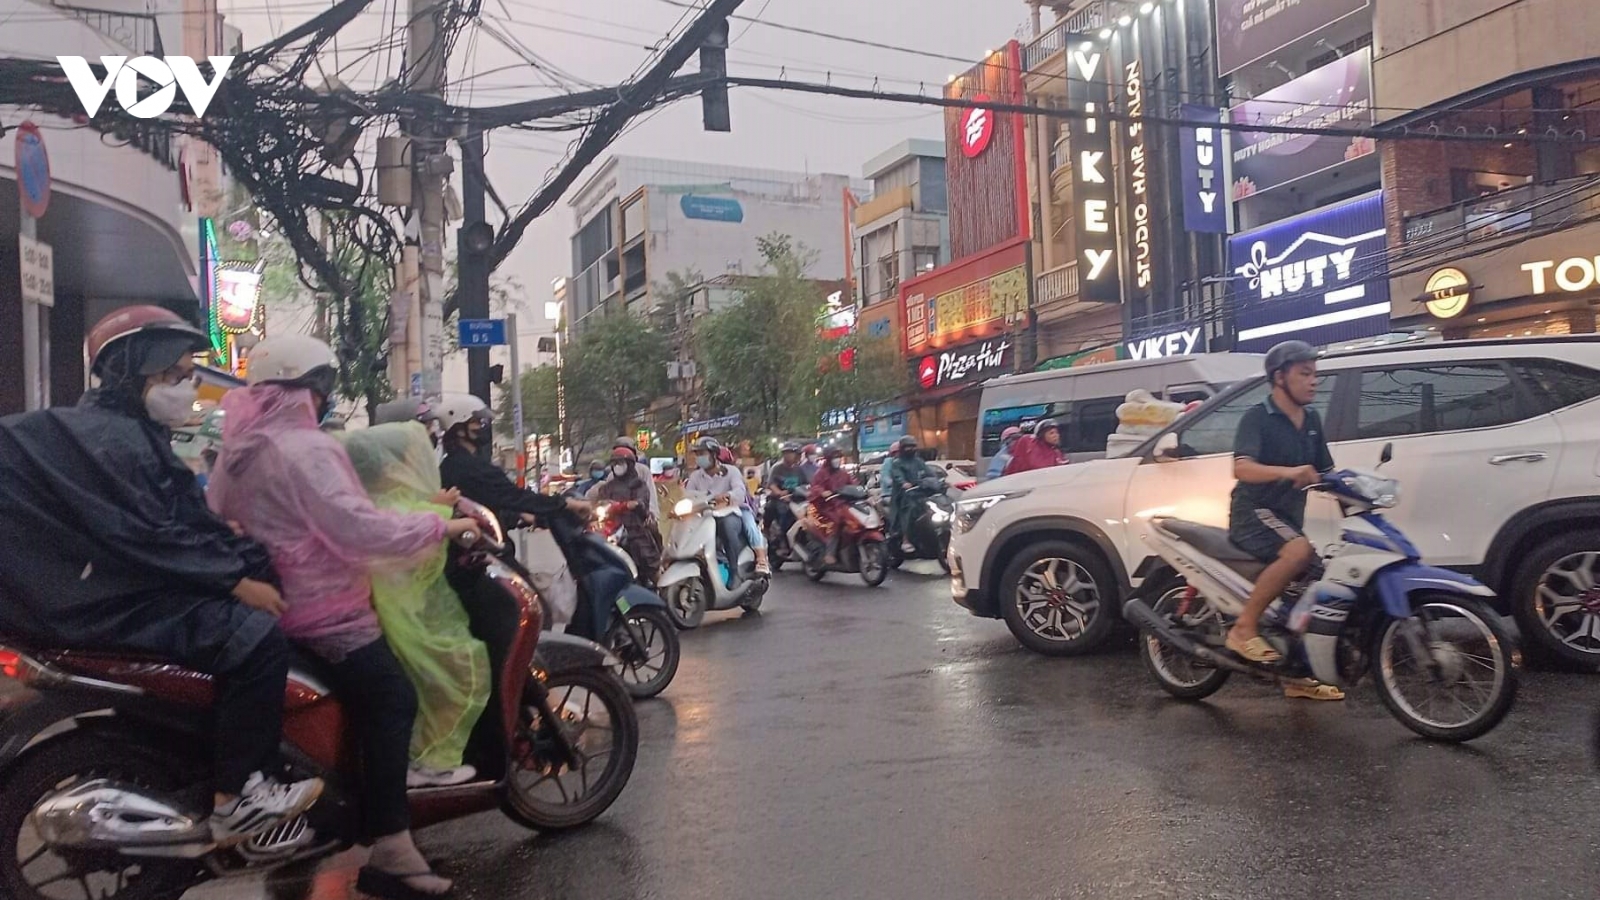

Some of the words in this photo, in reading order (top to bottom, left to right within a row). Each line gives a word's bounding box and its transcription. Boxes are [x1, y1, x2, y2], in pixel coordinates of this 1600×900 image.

[1125, 59, 1142, 136] SALON
[1131, 143, 1145, 195] HAIR
[1196, 127, 1217, 213] NUTY
[1135, 203, 1150, 288] STUDIO
[1260, 247, 1356, 299] NUTY
[1521, 255, 1600, 295] TO
[937, 352, 977, 386] Pizza
[976, 341, 1013, 372] Hut
[1127, 326, 1201, 360] VIKEY
